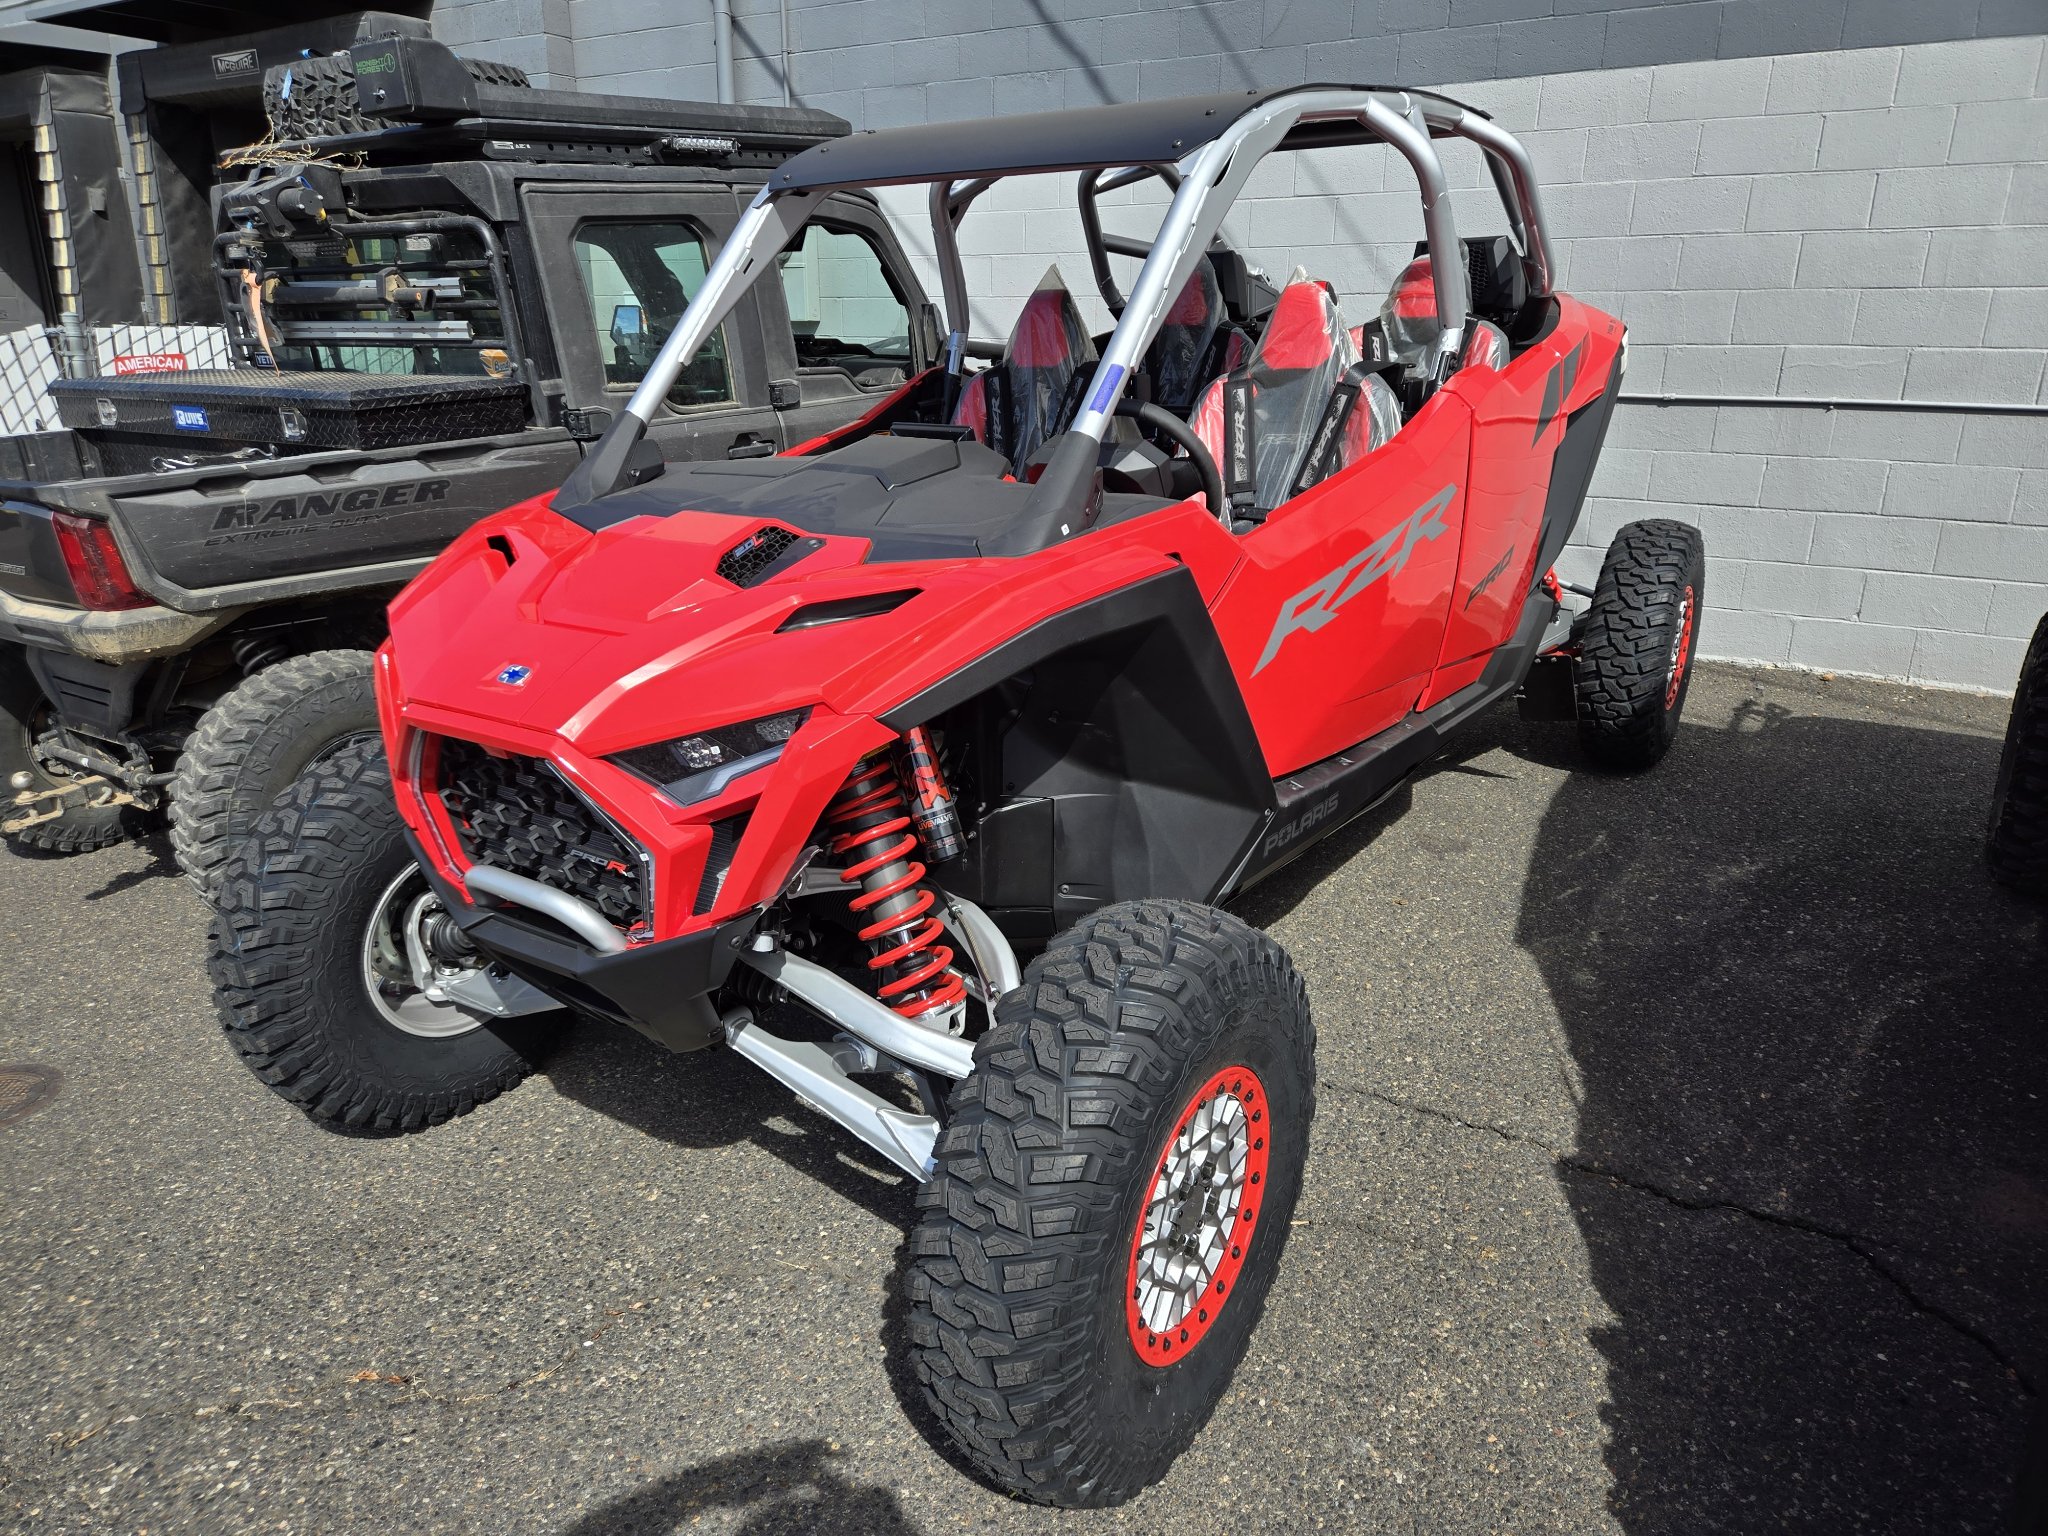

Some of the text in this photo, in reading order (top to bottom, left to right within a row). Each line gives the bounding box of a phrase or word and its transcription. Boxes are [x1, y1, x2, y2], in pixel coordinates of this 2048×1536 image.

[117, 356, 183, 373] AMERICAN
[256, 355, 273, 364] YETI
[1234, 411, 1247, 459] RZR
[1311, 416, 1338, 467] RZR
[203, 513, 389, 547] EXTREME DUTY
[212, 480, 452, 531] RANGER
[1250, 482, 1457, 679] RZR
[1464, 544, 1515, 612] PRO
[1263, 791, 1339, 858] POLARIS
